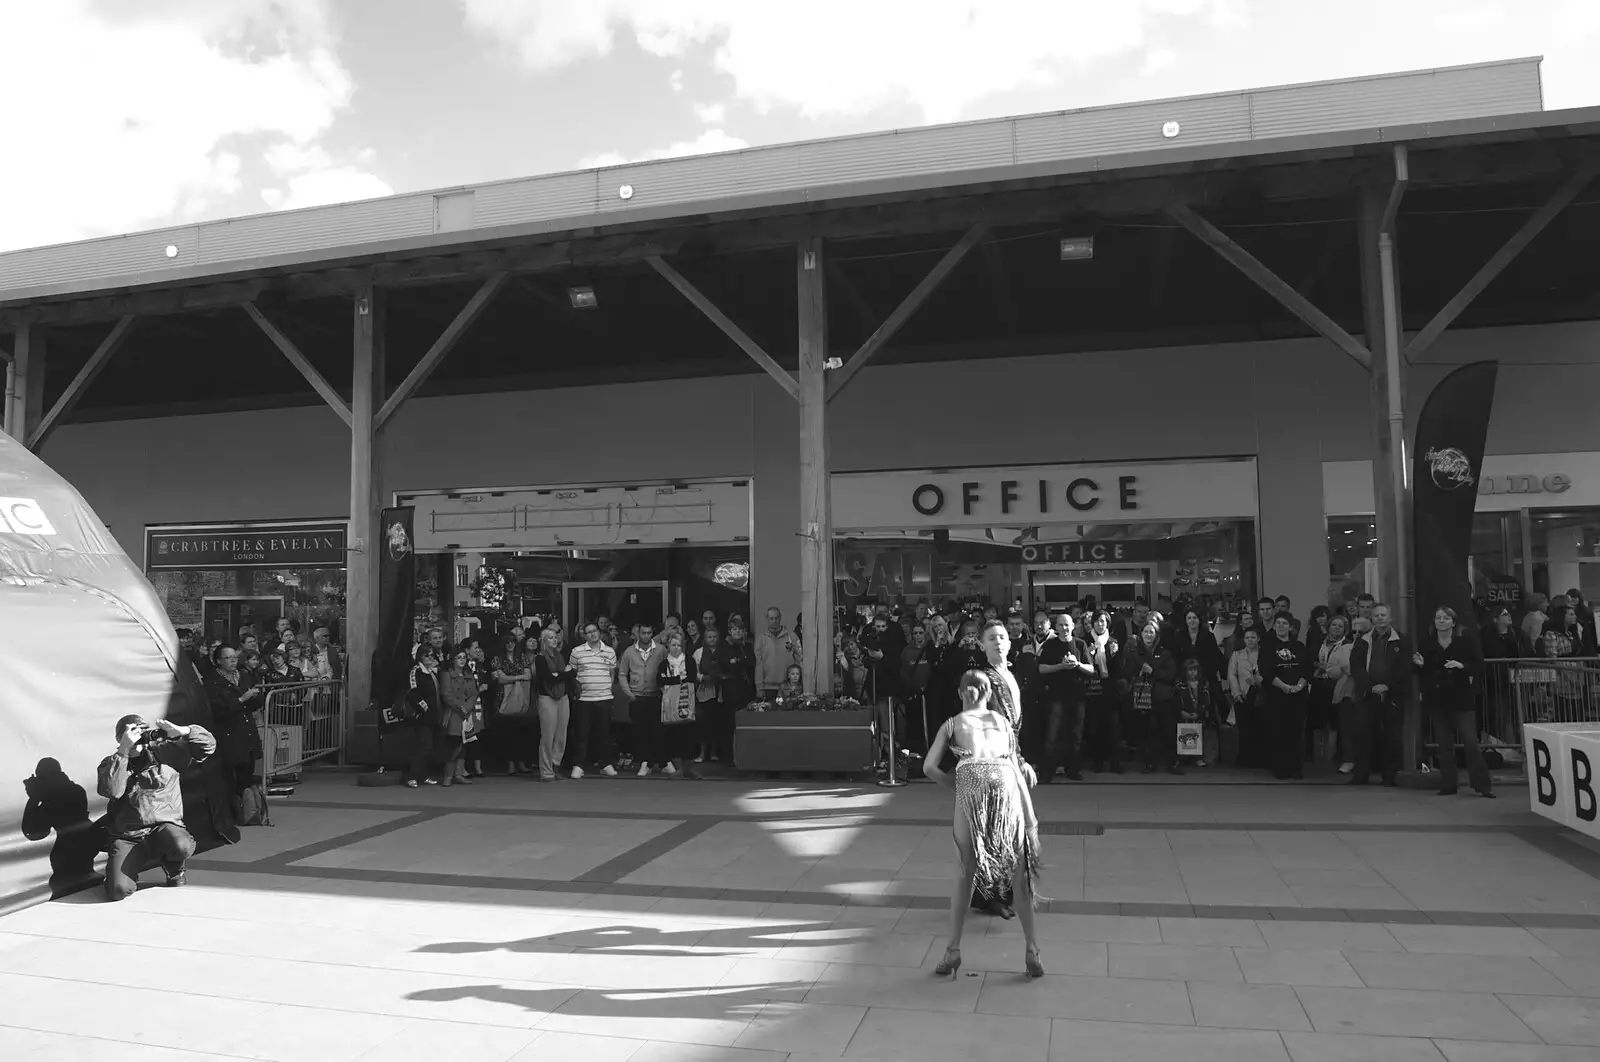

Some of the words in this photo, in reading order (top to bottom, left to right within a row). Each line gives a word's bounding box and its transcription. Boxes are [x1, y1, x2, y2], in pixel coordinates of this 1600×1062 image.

[912, 475, 1138, 516] OFFICE
[171, 539, 251, 553] CRABTREE
[255, 539, 265, 551] &
[270, 537, 334, 551] EVELYN
[1022, 544, 1124, 561] OFFICE
[233, 553, 265, 561] LONDON
[844, 552, 957, 597] SALE
[1488, 589, 1520, 602] SALE
